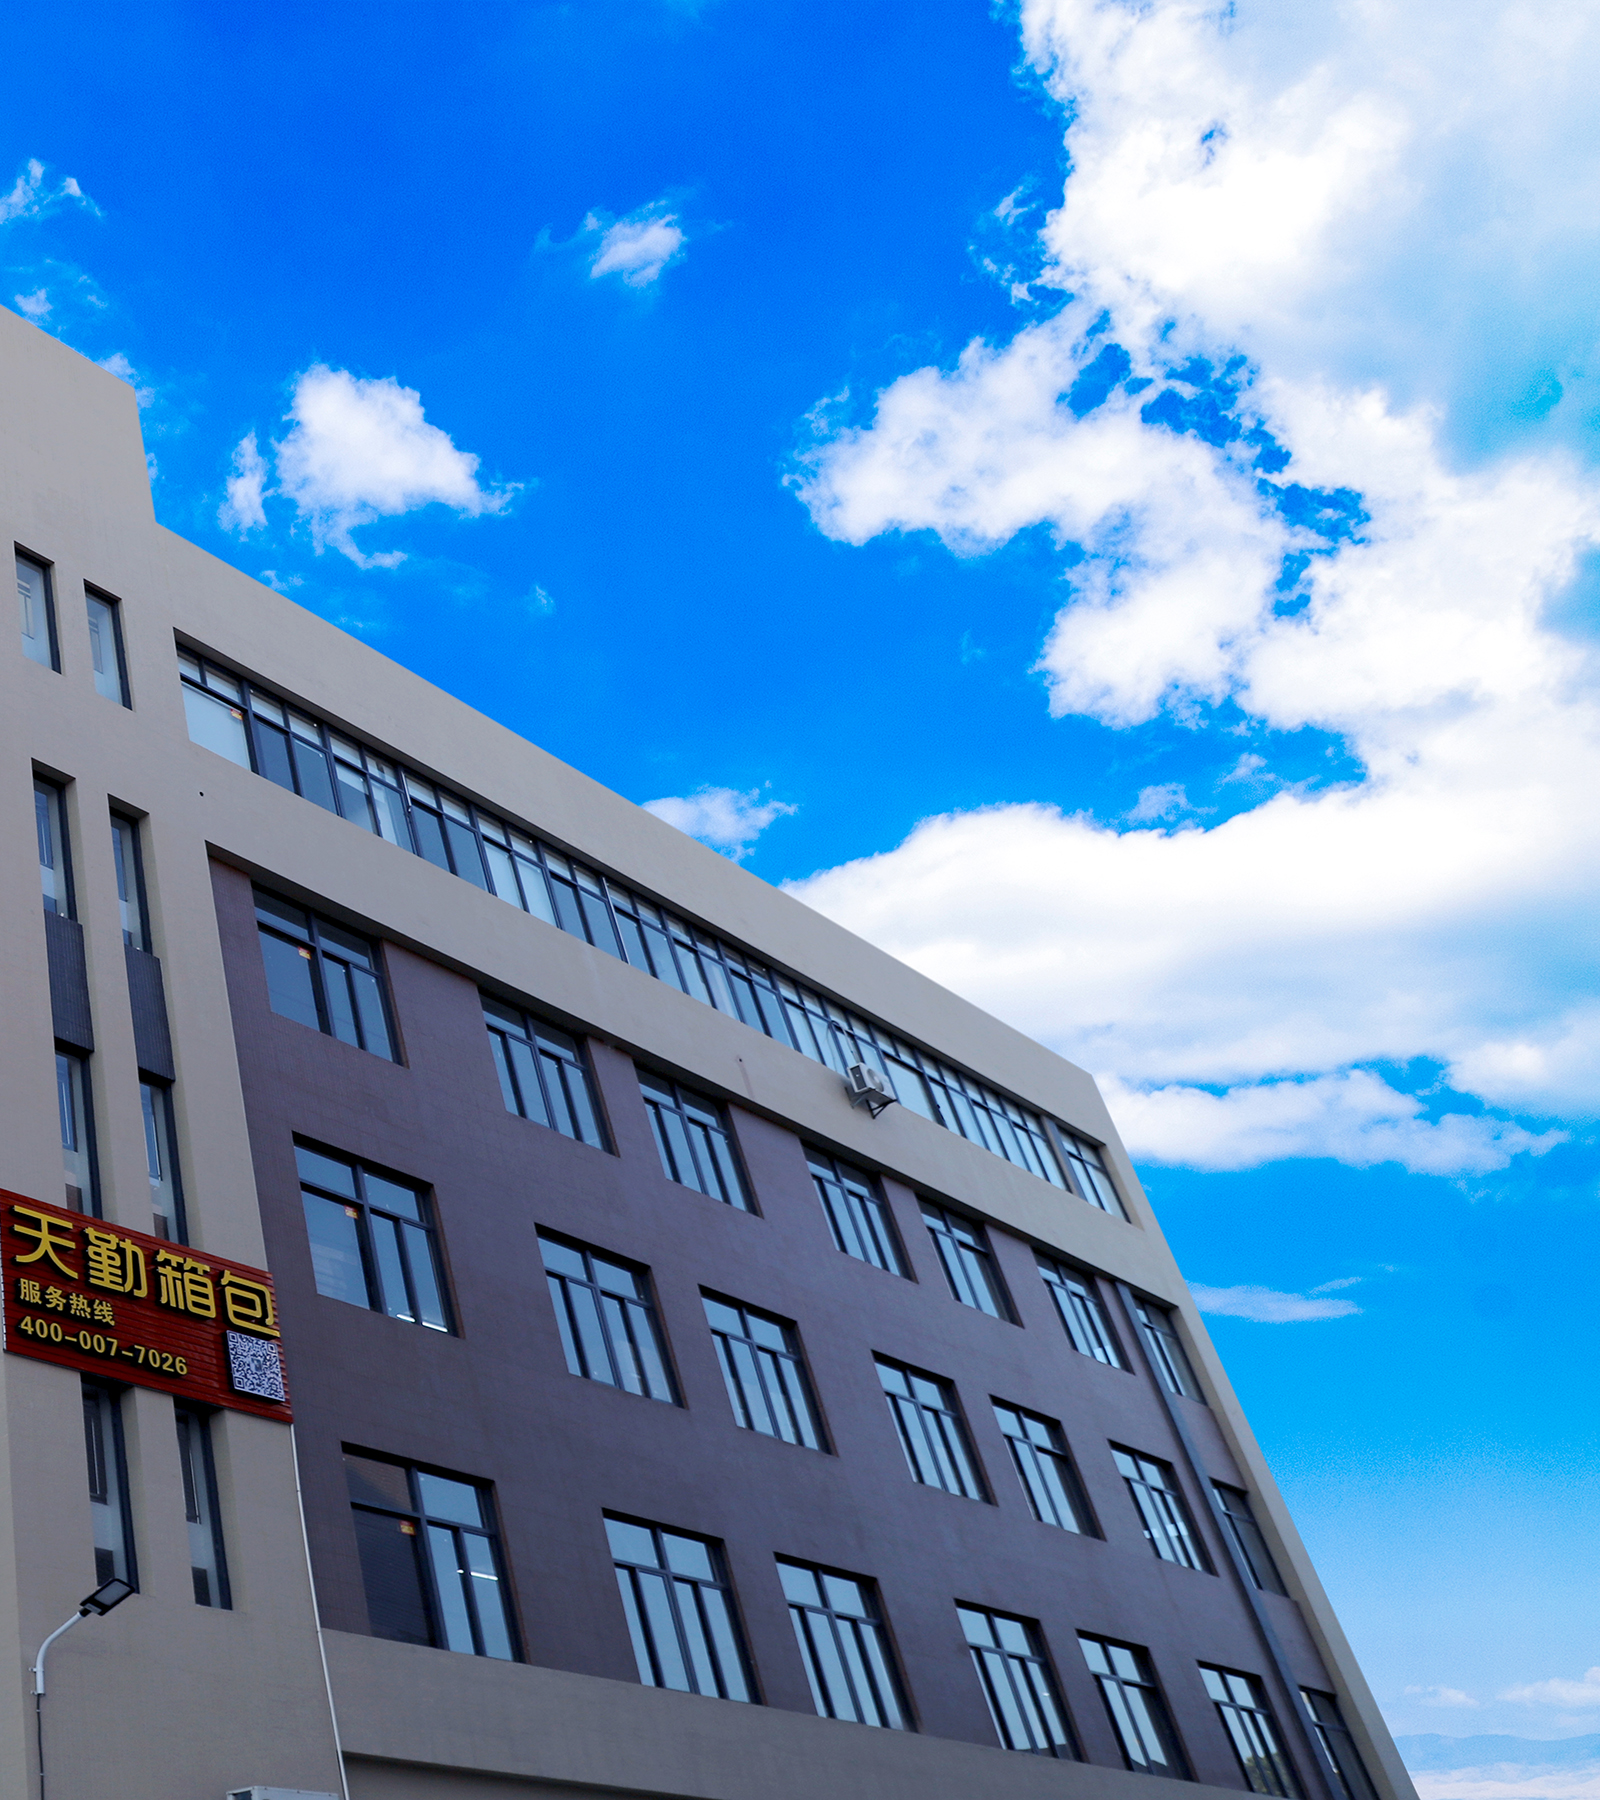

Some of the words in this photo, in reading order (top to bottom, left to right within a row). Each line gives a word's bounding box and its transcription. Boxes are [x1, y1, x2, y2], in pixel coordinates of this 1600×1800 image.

[13, 1205, 280, 1337] 天勤箱包
[19, 1278, 115, 1326] 服务热线
[20, 1315, 188, 1376] 400-007-7026
